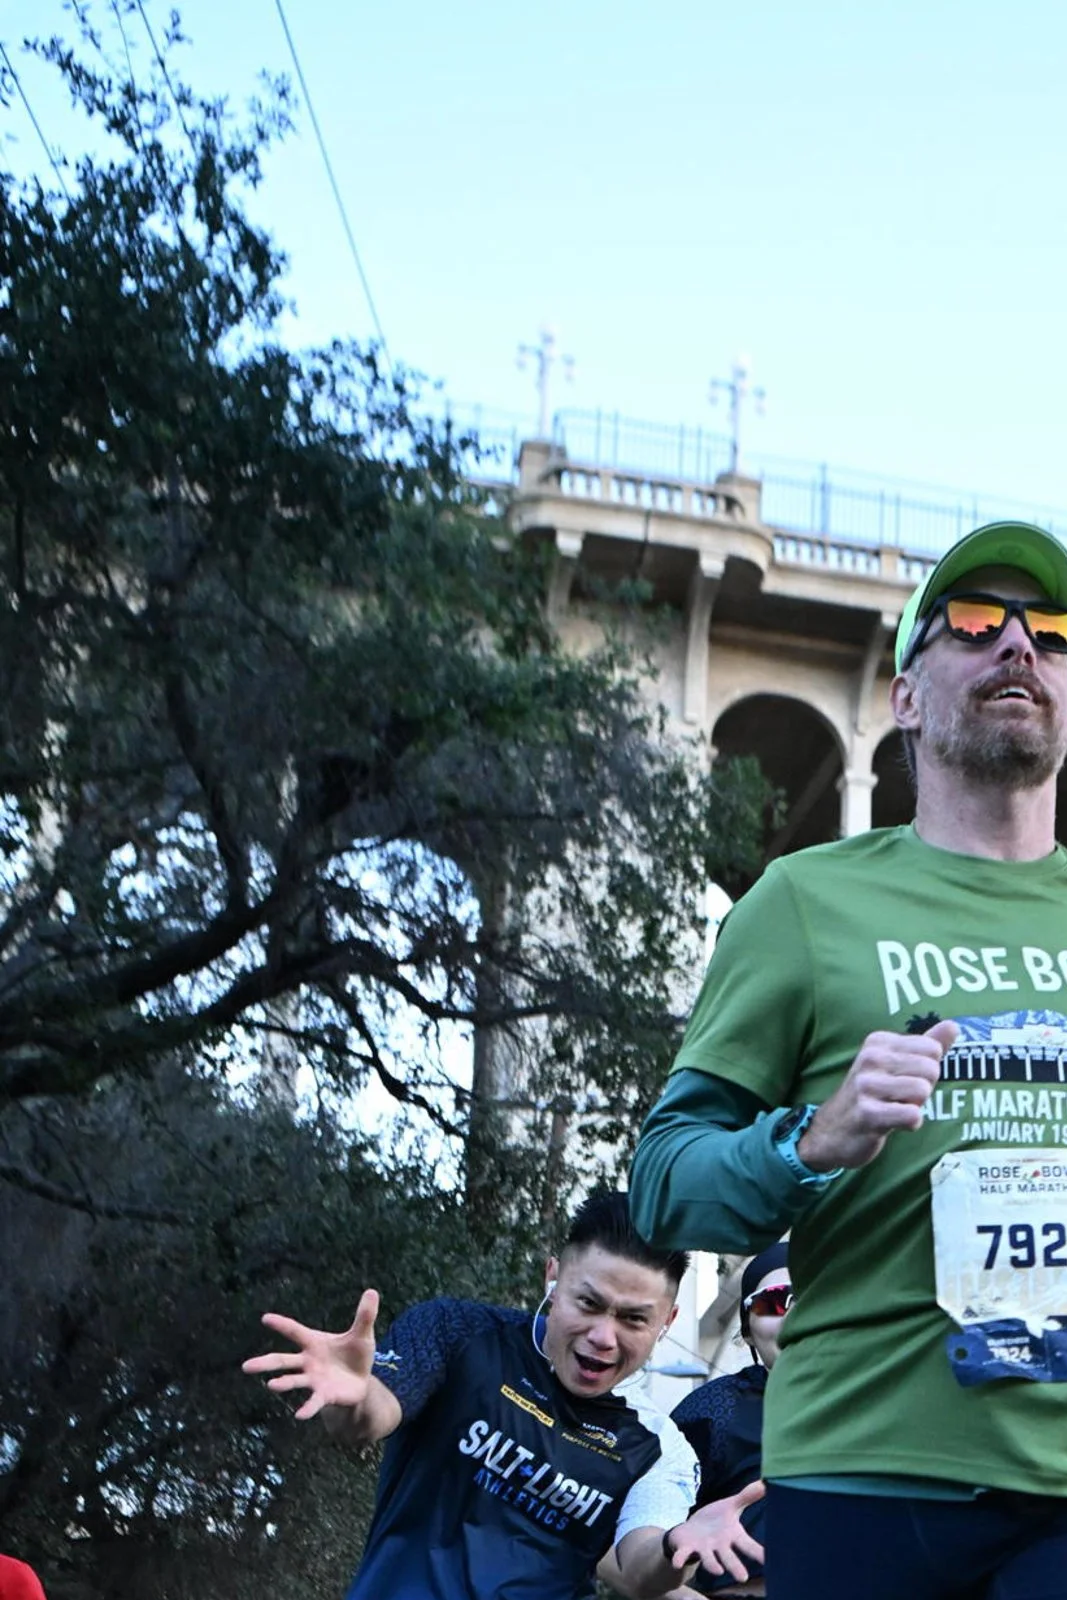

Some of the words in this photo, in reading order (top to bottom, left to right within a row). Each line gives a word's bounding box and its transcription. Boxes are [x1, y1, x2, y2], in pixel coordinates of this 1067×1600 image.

[876, 940, 1019, 1015] ROSE
[921, 1089, 967, 1121] ALF
[959, 1122, 1044, 1143] JANUARY
[979, 1166, 1022, 1179] ROSE
[979, 1184, 1012, 1194] HALF
[473, 1467, 570, 1530] ATHLETICS
